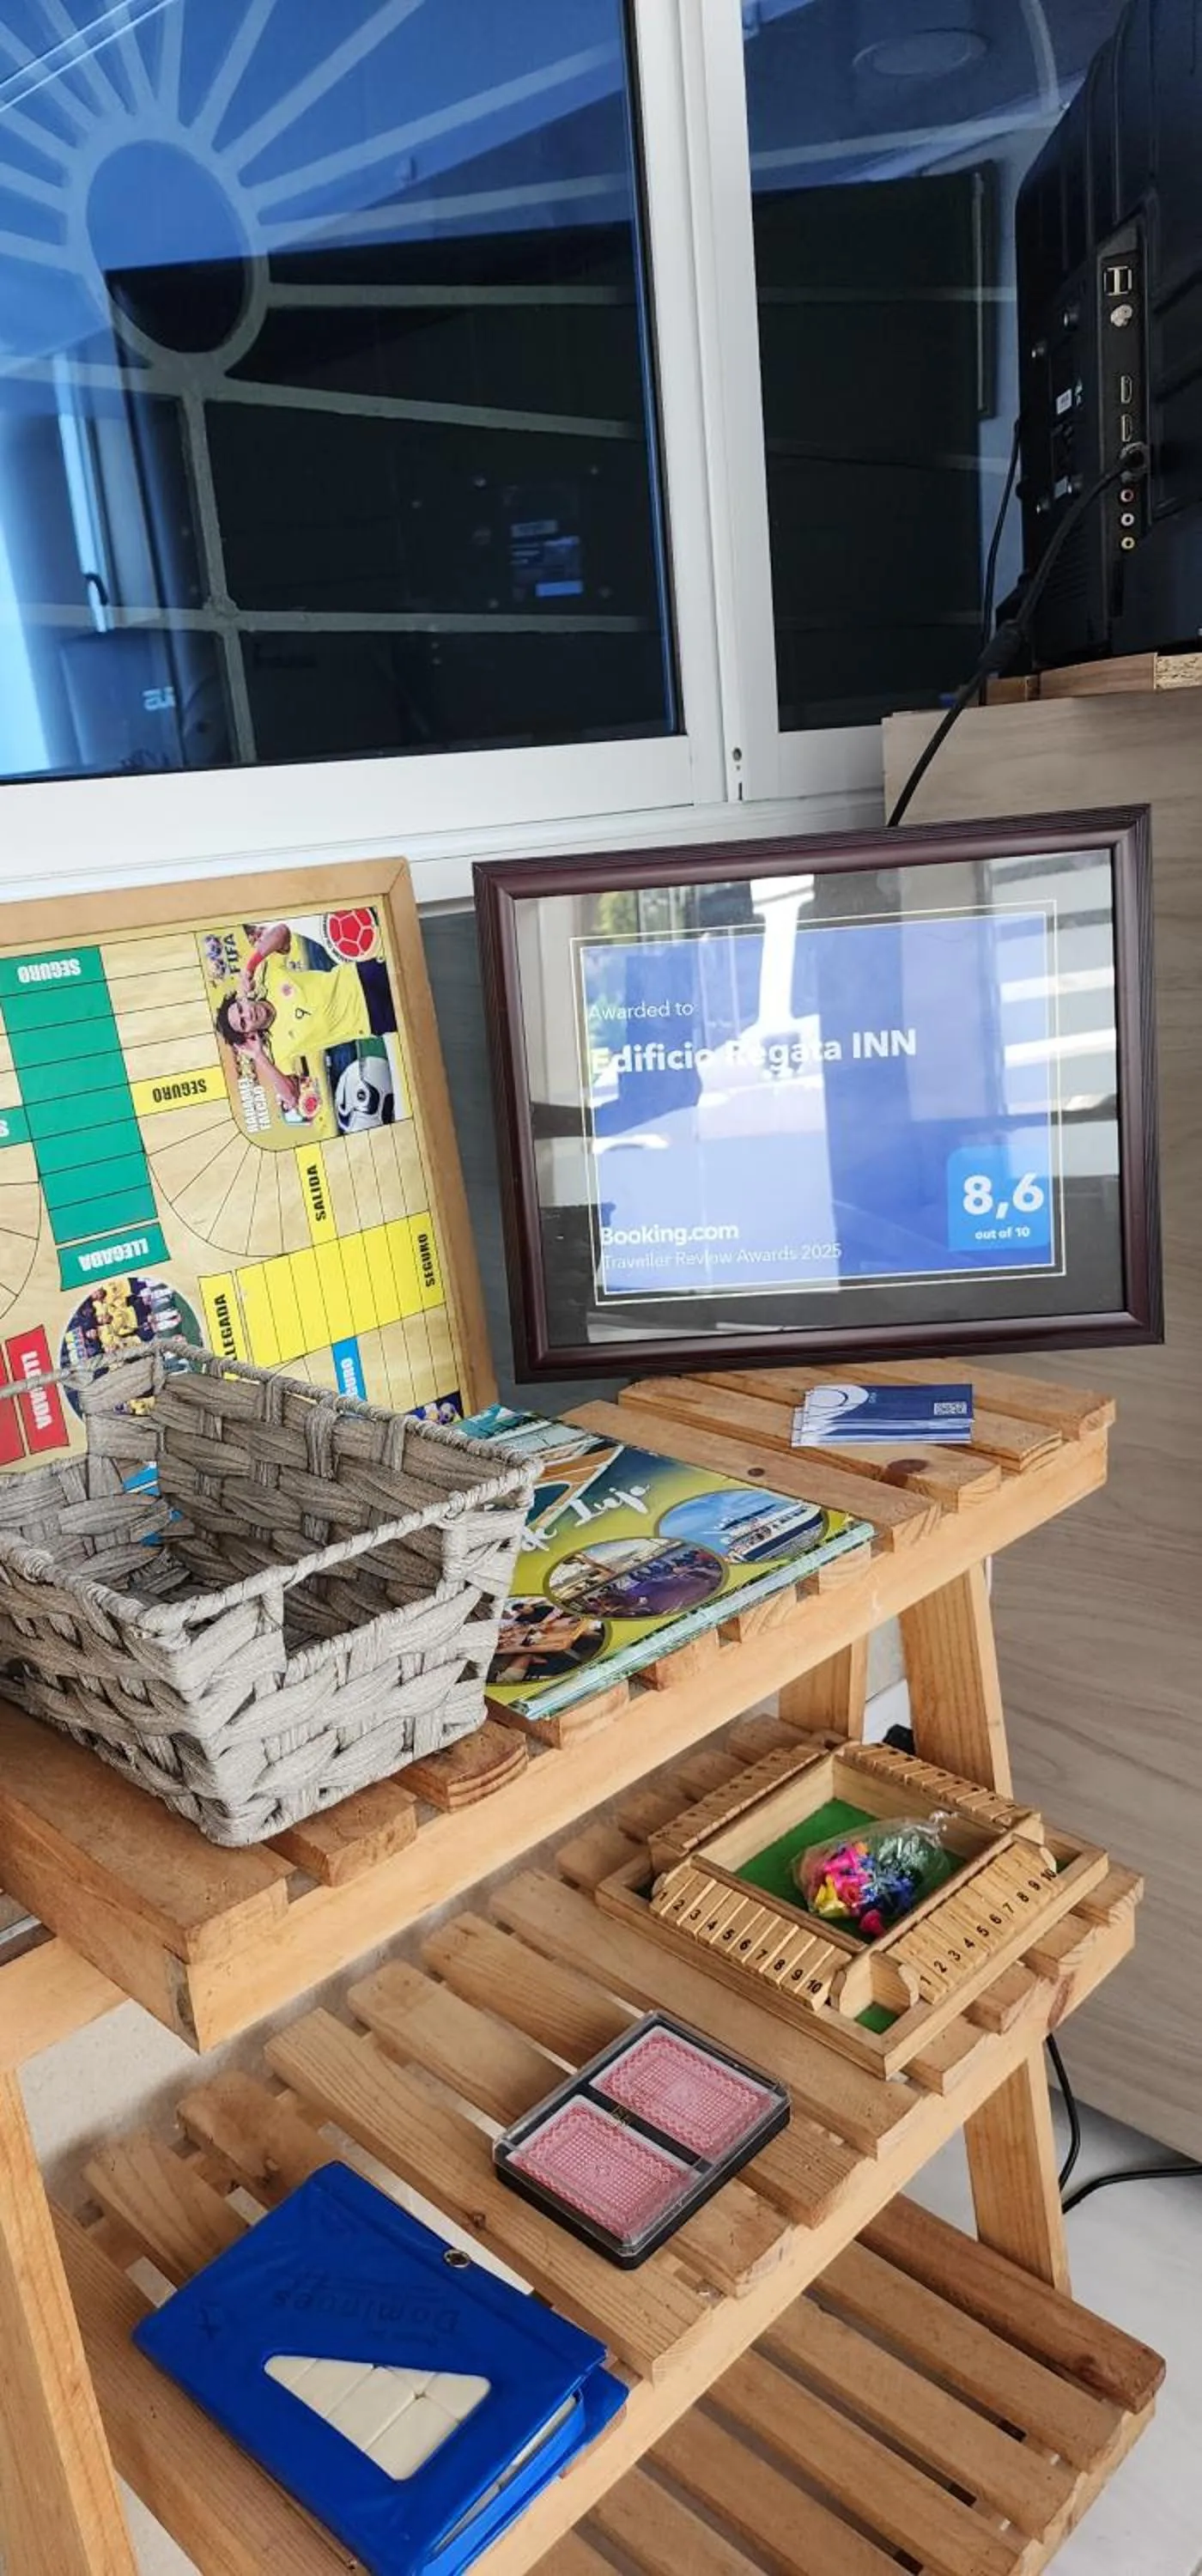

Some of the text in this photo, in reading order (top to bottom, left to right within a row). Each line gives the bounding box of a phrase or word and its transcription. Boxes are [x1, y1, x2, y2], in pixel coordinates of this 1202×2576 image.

[17, 958, 82, 983] SEGURO
[223, 933, 240, 974] FIFA
[589, 999, 695, 1020] Awarded to
[591, 1042, 713, 1073] Edificio
[853, 1029, 916, 1058] INN
[152, 1078, 207, 1103] SEGURO
[307, 1163, 327, 1222] SALIDA
[962, 1173, 1044, 1219] 8,6
[77, 1237, 149, 1272] LLEGADA
[602, 1224, 739, 1246] Booking.com
[737, 1246, 797, 1263] Awards
[802, 1242, 841, 1261] 2025
[974, 1226, 1030, 1240] out of 10
[417, 1233, 436, 1288] SEGURO
[214, 1293, 238, 1361] LEGADA
[21, 1351, 52, 1430] LLEADA
[570, 1484, 651, 1528] Lujo
[659, 1891, 823, 1994] 1 2 3 4 5 6 7 8 9 10
[920, 1868, 1057, 1985] 1 2 3 4 5 6 7 8 9 10
